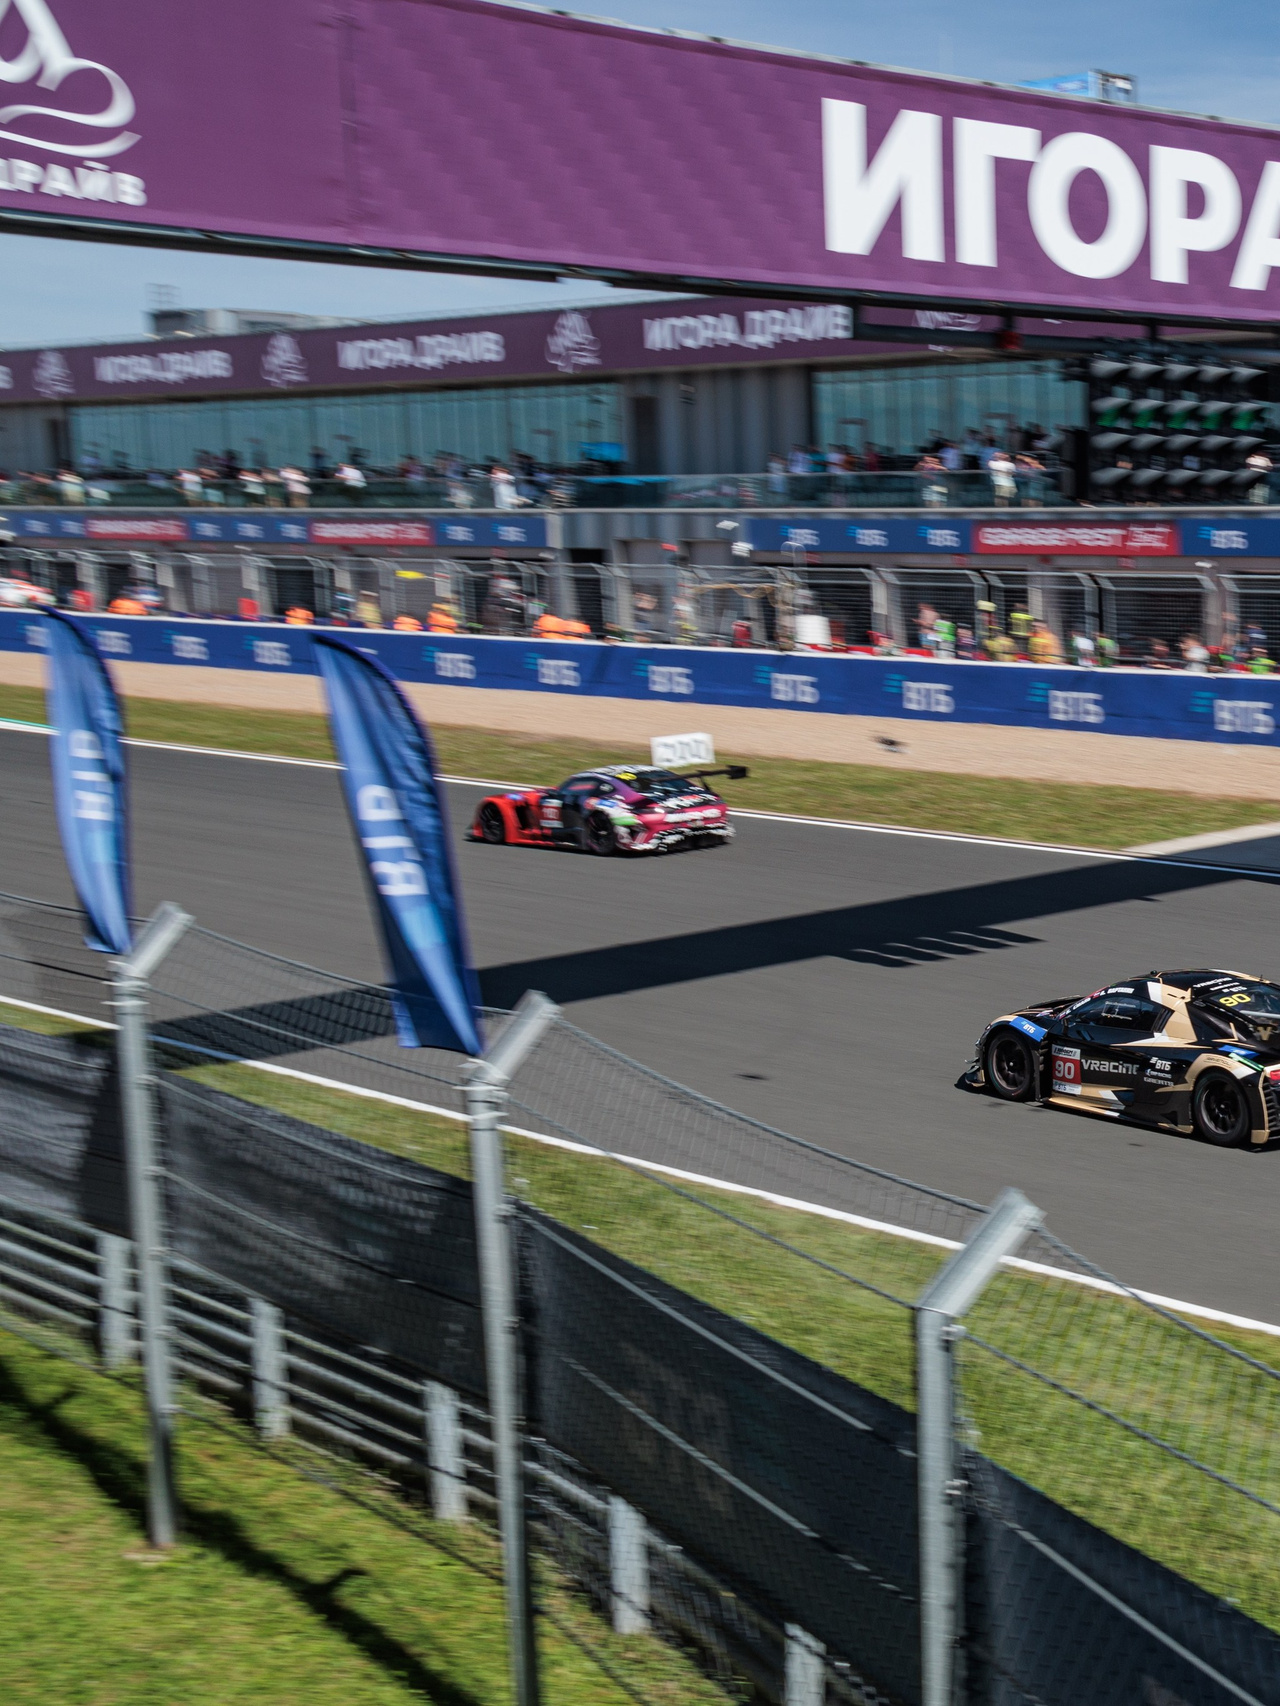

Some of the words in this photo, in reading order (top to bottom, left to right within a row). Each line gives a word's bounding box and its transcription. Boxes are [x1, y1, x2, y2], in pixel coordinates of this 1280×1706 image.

[1219, 993, 1251, 1007] 90
[1055, 1061, 1075, 1080] 90
[1155, 1061, 1171, 1071] ВТБ
